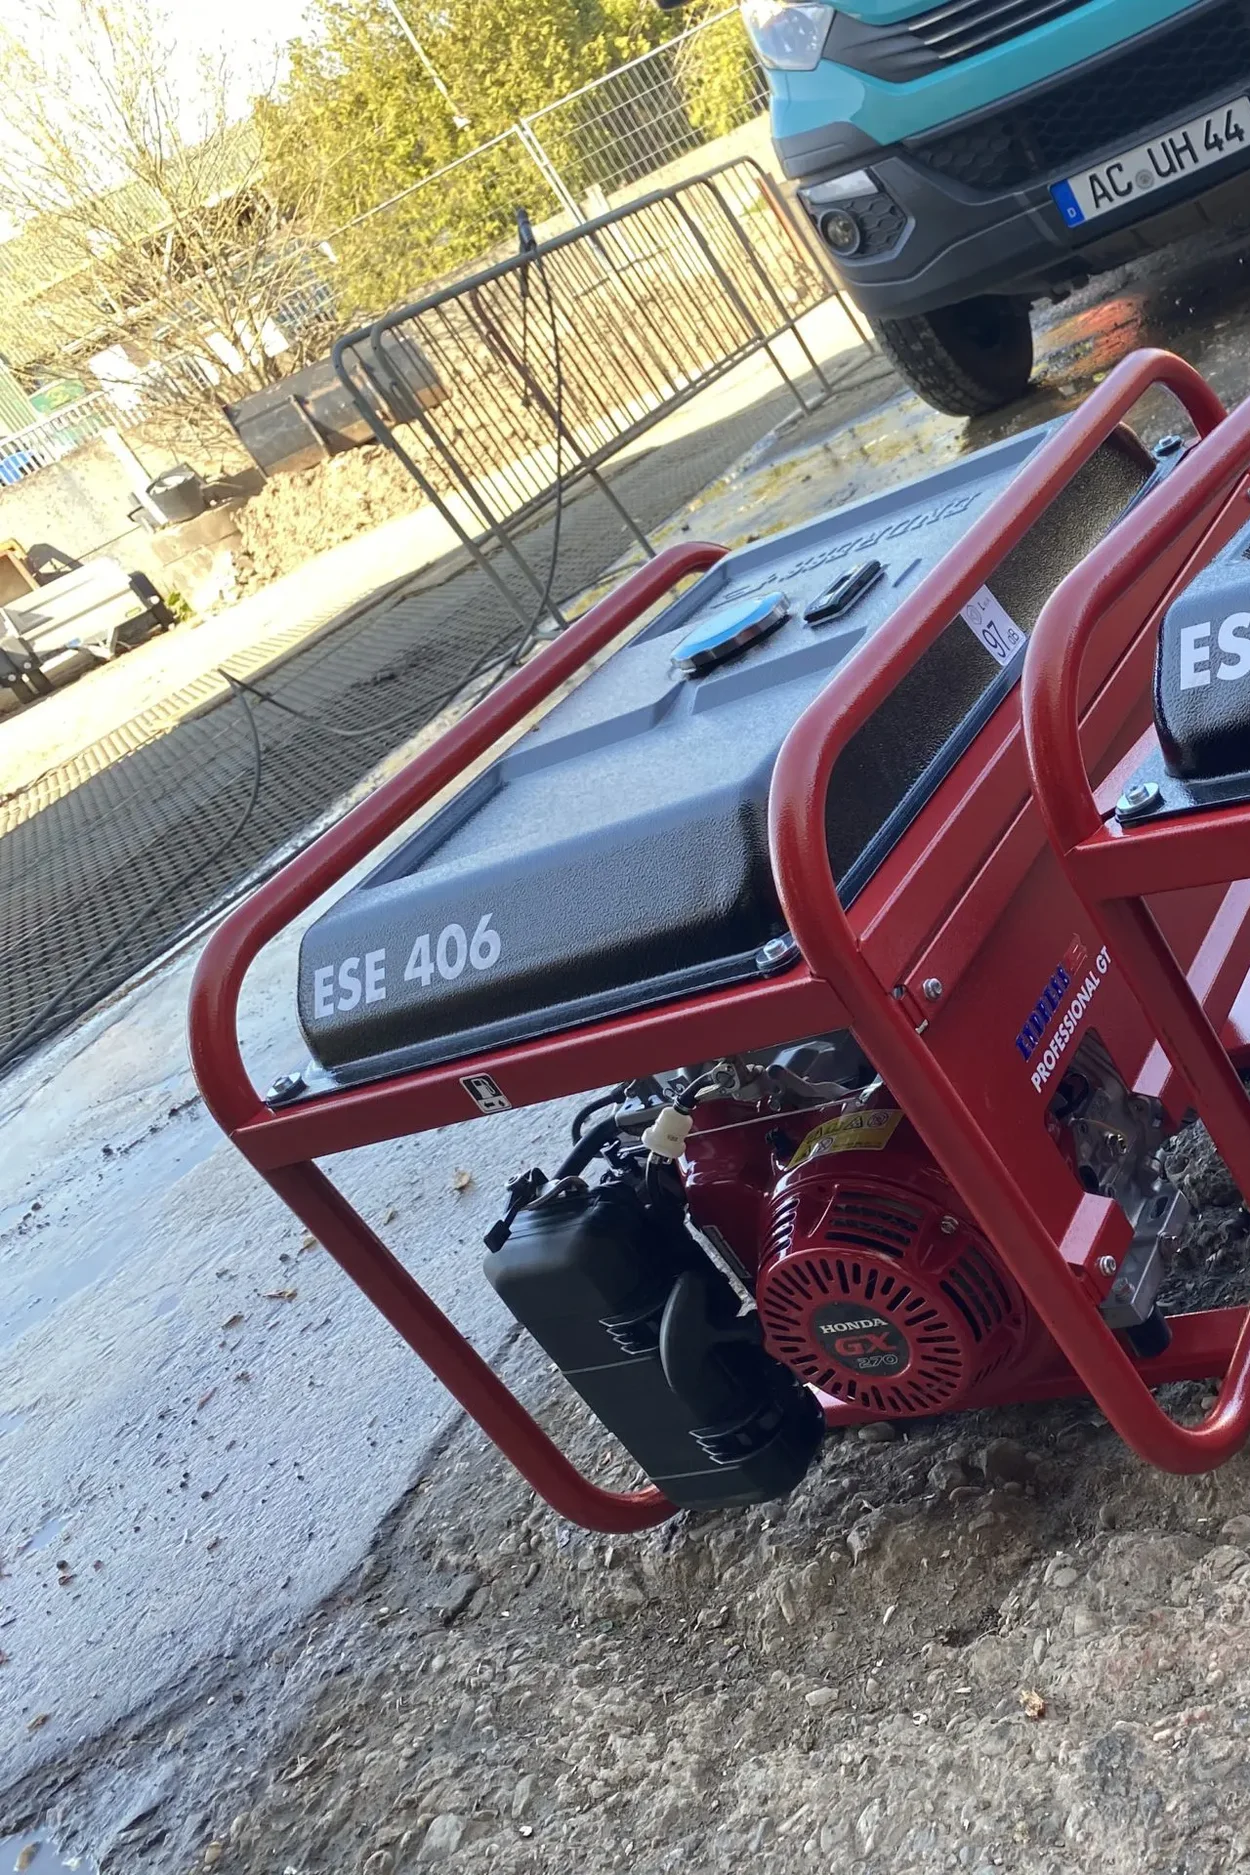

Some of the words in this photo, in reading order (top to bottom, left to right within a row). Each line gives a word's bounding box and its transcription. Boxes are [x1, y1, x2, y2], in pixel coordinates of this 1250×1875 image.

[1088, 163, 1133, 208] AC
[1147, 131, 1199, 177] UH
[1203, 109, 1245, 152] 44
[1066, 207, 1077, 218] D
[982, 620, 1011, 658] 97
[1007, 628, 1020, 645] dB
[314, 948, 386, 1020] ESE
[404, 912, 501, 987] 406
[1030, 971, 1101, 1094] PROFESSIONAL
[1095, 945, 1113, 975] GT
[819, 1317, 889, 1334] HONDA
[835, 1331, 897, 1357] GX
[856, 1354, 899, 1369] 270
